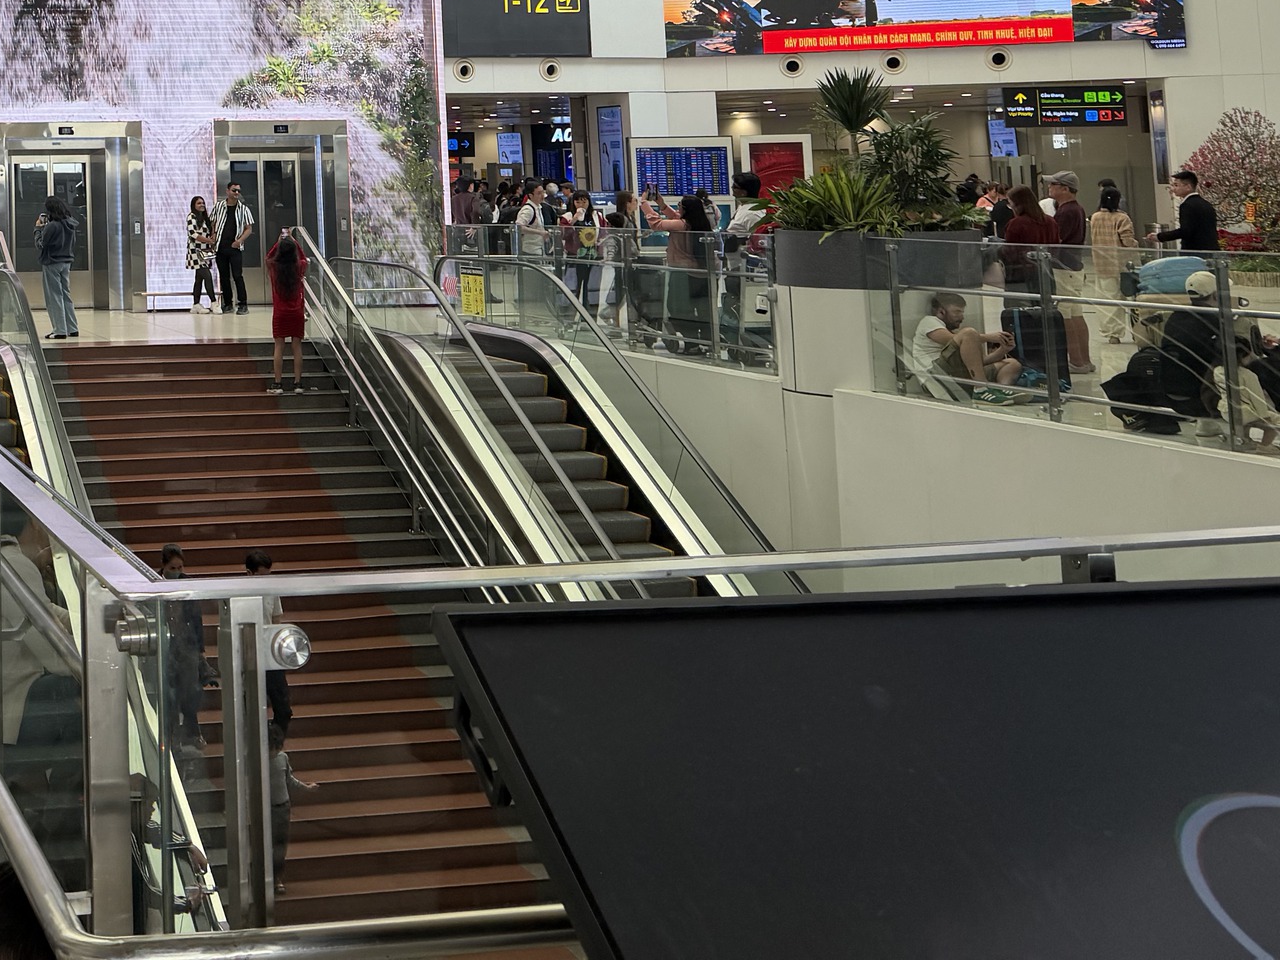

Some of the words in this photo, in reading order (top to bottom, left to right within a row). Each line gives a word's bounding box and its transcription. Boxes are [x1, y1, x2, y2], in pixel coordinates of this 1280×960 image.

[784, 36, 797, 48] XÂY
[799, 36, 818, 49] DỰNG
[819, 34, 838, 47] QUÂN
[840, 34, 852, 49] ĐỘI
[853, 33, 872, 46] NHÂN
[874, 33, 888, 45] DÂN
[890, 32, 909, 44] CÁCH
[910, 32, 934, 45] MẠNG,
[935, 29, 957, 42] CHÍNH
[977, 29, 994, 40] TINH
[1018, 26, 1035, 41] HIỆN
[551, 127, 572, 143] AC
